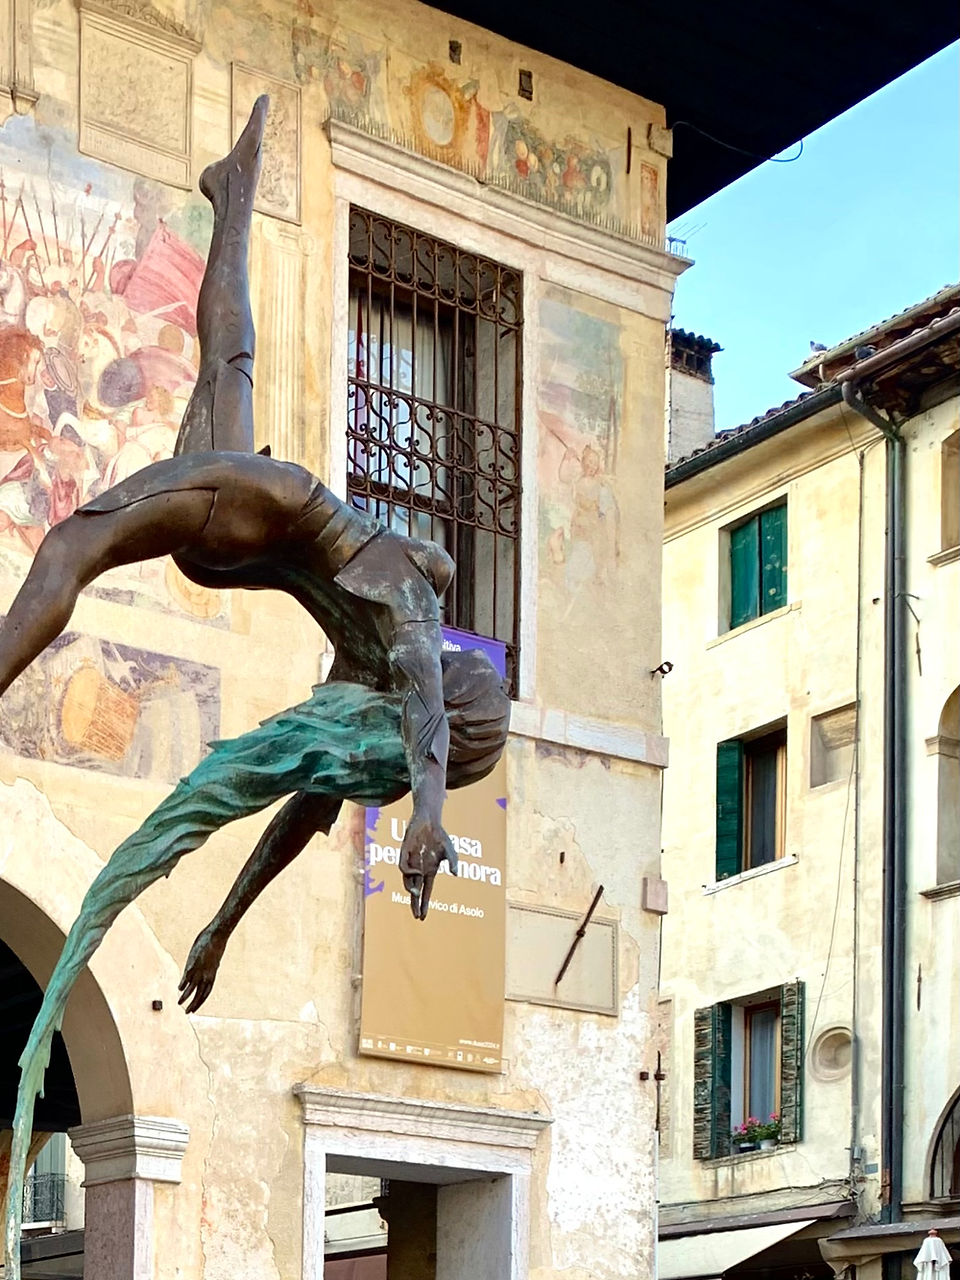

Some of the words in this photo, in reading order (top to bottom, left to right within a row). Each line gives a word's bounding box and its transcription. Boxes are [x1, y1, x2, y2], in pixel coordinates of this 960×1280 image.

[448, 834, 482, 858] asa
[449, 902, 458, 914] di
[459, 904, 484, 919] Asolo
